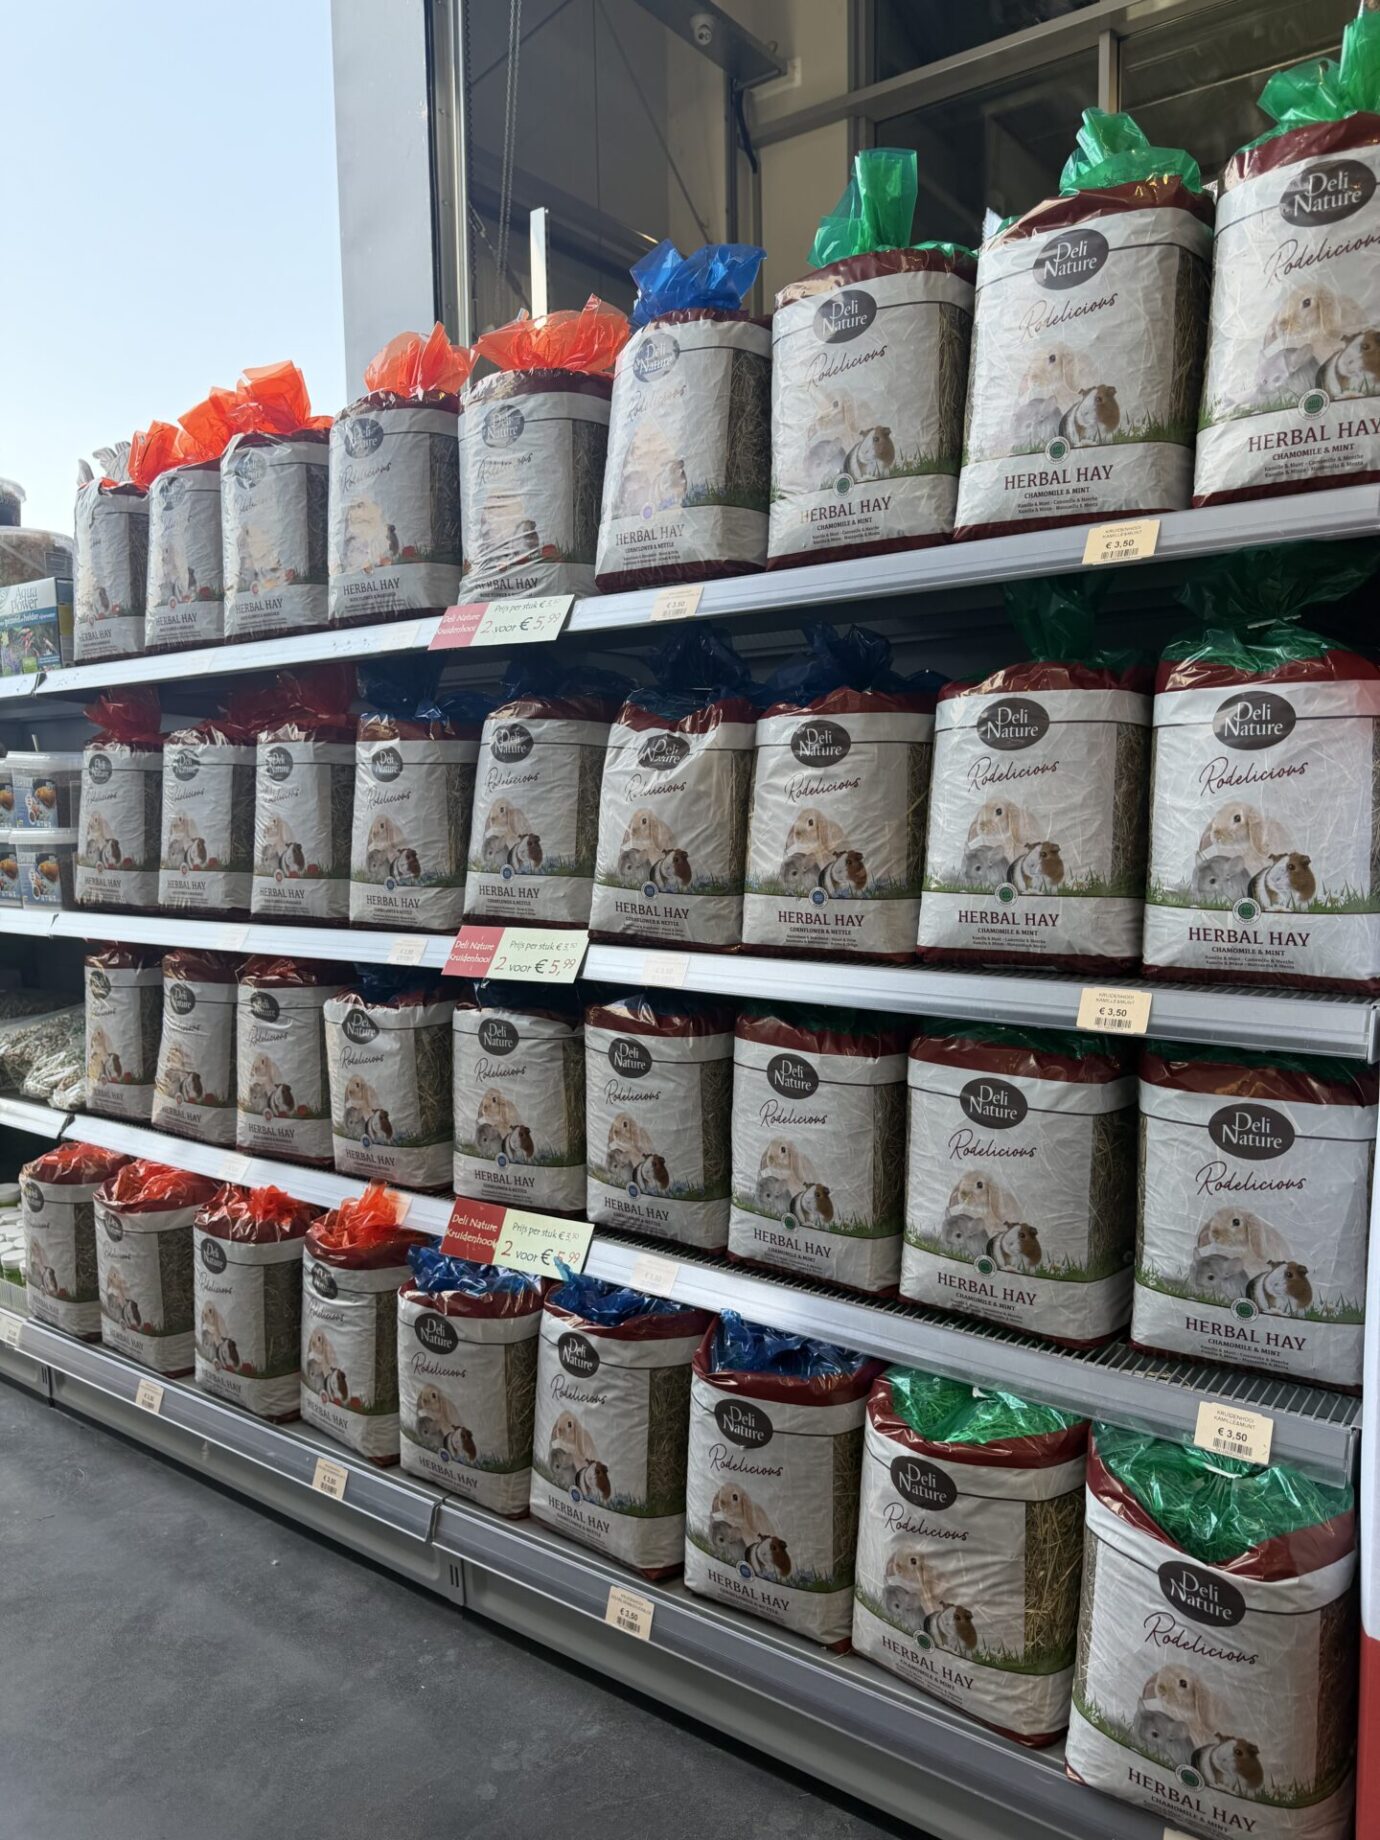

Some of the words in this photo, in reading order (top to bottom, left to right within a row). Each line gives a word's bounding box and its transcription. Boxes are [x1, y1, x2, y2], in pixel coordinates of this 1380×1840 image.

[1304, 170, 1349, 196] Deli
[1294, 188, 1362, 217] Nature
[1057, 240, 1088, 262] Deli
[1043, 254, 1098, 282] Nature
[832, 300, 858, 318] Deli
[1018, 293, 1119, 343] Rodelicious
[822, 312, 868, 334] Nature
[1248, 424, 1331, 452] HERBAL
[1272, 448, 1322, 460] CHAMOMILE
[1332, 443, 1355, 452] MINT
[1004, 468, 1071, 490] HERBAL
[1076, 464, 1114, 482] HAY
[1024, 490, 1064, 500] CHAMOMILE
[1072, 486, 1090, 494] MINT
[800, 502, 856, 524] HERBAL
[860, 496, 892, 514] HAY
[616, 528, 658, 546] HERBAL
[660, 524, 685, 540] HAY
[343, 580, 379, 596] HERBAL
[380, 577, 400, 590] HAY
[480, 620, 493, 634] 2
[494, 624, 516, 634] voor
[520, 616, 533, 631] €
[997, 707, 1028, 726] Deli
[1233, 700, 1272, 722] Deli
[806, 726, 832, 747] Deli
[987, 720, 1039, 739] Nature
[1223, 716, 1284, 738] Nature
[800, 738, 842, 758] Nature
[967, 756, 1060, 792] Rodelicious
[1199, 756, 1308, 796] Rodelicious
[784, 773, 862, 804] Rodelicious
[288, 890, 304, 900] HAY
[366, 894, 400, 908] HERBAL
[401, 898, 421, 909] HAY
[478, 884, 516, 898] HERBAL
[518, 888, 540, 900] HAY
[616, 901, 661, 917] HERBAL
[664, 906, 690, 920] HAY
[778, 910, 831, 926] HERBAL
[835, 914, 864, 927] HAY
[958, 910, 1020, 926] HERBAL
[1024, 912, 1060, 927] HAY
[470, 941, 495, 951] Nature
[526, 943, 538, 952] per
[538, 942, 554, 951] stuk
[555, 942, 562, 951] €
[1188, 926, 1264, 945] HERBAL
[1269, 931, 1310, 947] HAY
[1212, 946, 1256, 955] CHAMOMILE
[494, 956, 508, 970] 2
[509, 964, 532, 973] voor
[534, 959, 548, 974] €
[1099, 1007, 1106, 1015] €
[1108, 1008, 1127, 1017] 3,50
[346, 1021, 376, 1037] Nature
[488, 1022, 507, 1038] Deli
[484, 1033, 513, 1048] Nature
[618, 1042, 640, 1060] Deli
[474, 1057, 526, 1083] Rodelicious
[614, 1054, 646, 1070] Nature
[781, 1060, 804, 1078] Deli
[604, 1078, 662, 1105] Rodelicious
[774, 1070, 812, 1092] Nature
[978, 1084, 1010, 1105] Deli
[759, 1098, 828, 1128] Rodelicious
[969, 1099, 1018, 1120] Nature
[249, 1124, 276, 1137] HERBAL
[278, 1128, 295, 1139] HAY
[1232, 1111, 1271, 1134] Deli
[948, 1128, 1038, 1160] Rodelicious
[1222, 1124, 1282, 1150] Nature
[346, 1149, 376, 1164] HERBAL
[378, 1156, 396, 1167] HAY
[474, 1170, 512, 1184] HERBAL
[514, 1176, 535, 1188] HAY
[1195, 1160, 1308, 1196] Rodelicious
[604, 1196, 644, 1216] HERBAL
[646, 1206, 670, 1221] HAY
[451, 1214, 468, 1226] Deli
[468, 1218, 498, 1232] Nature
[512, 1222, 528, 1235] Prijs
[528, 1226, 541, 1238] per
[542, 1228, 558, 1239] stuk
[558, 1232, 565, 1240] €
[500, 1240, 513, 1256] 2
[515, 1250, 538, 1262] voor
[540, 1248, 554, 1266] €
[754, 1228, 802, 1252] HERBAL
[805, 1242, 832, 1258] HAY
[938, 1272, 998, 1298] HERBAL
[1002, 1288, 1036, 1306] HAY
[420, 1327, 453, 1348] Nature
[426, 1318, 446, 1336] Deli
[1185, 1316, 1260, 1344] HERBAL
[1266, 1332, 1307, 1351] HAY
[562, 1346, 593, 1371] Nature
[568, 1338, 586, 1357] Deli
[1208, 1338, 1252, 1351] CHAMOMILE
[1260, 1348, 1281, 1357] MINT
[410, 1351, 468, 1378] Rodelicious
[550, 1373, 608, 1405] Rodelicious
[332, 1414, 349, 1430] HAY
[722, 1414, 764, 1442] Nature
[729, 1406, 756, 1428] Deli
[1218, 1427, 1224, 1436] €
[1226, 1430, 1248, 1442] 3,50
[708, 1443, 784, 1477] Rodelicious
[418, 1456, 455, 1481] HERBAL
[458, 1473, 478, 1489] HAY
[906, 1462, 936, 1488] Deli
[899, 1472, 948, 1504] Nature
[548, 1494, 586, 1526] HERBAL
[588, 1515, 611, 1534] HAY
[882, 1502, 970, 1541] Rodelicious
[708, 1568, 758, 1600] HERBAL
[760, 1592, 790, 1612] HAY
[1179, 1570, 1219, 1603] Deli
[1170, 1577, 1233, 1622] Nature
[1143, 1611, 1258, 1666] Rodelicious
[882, 1635, 938, 1675] HERBAL
[942, 1666, 974, 1690] HAY
[1128, 1766, 1207, 1815] HERBAL
[1212, 1806, 1256, 1833] HAY
